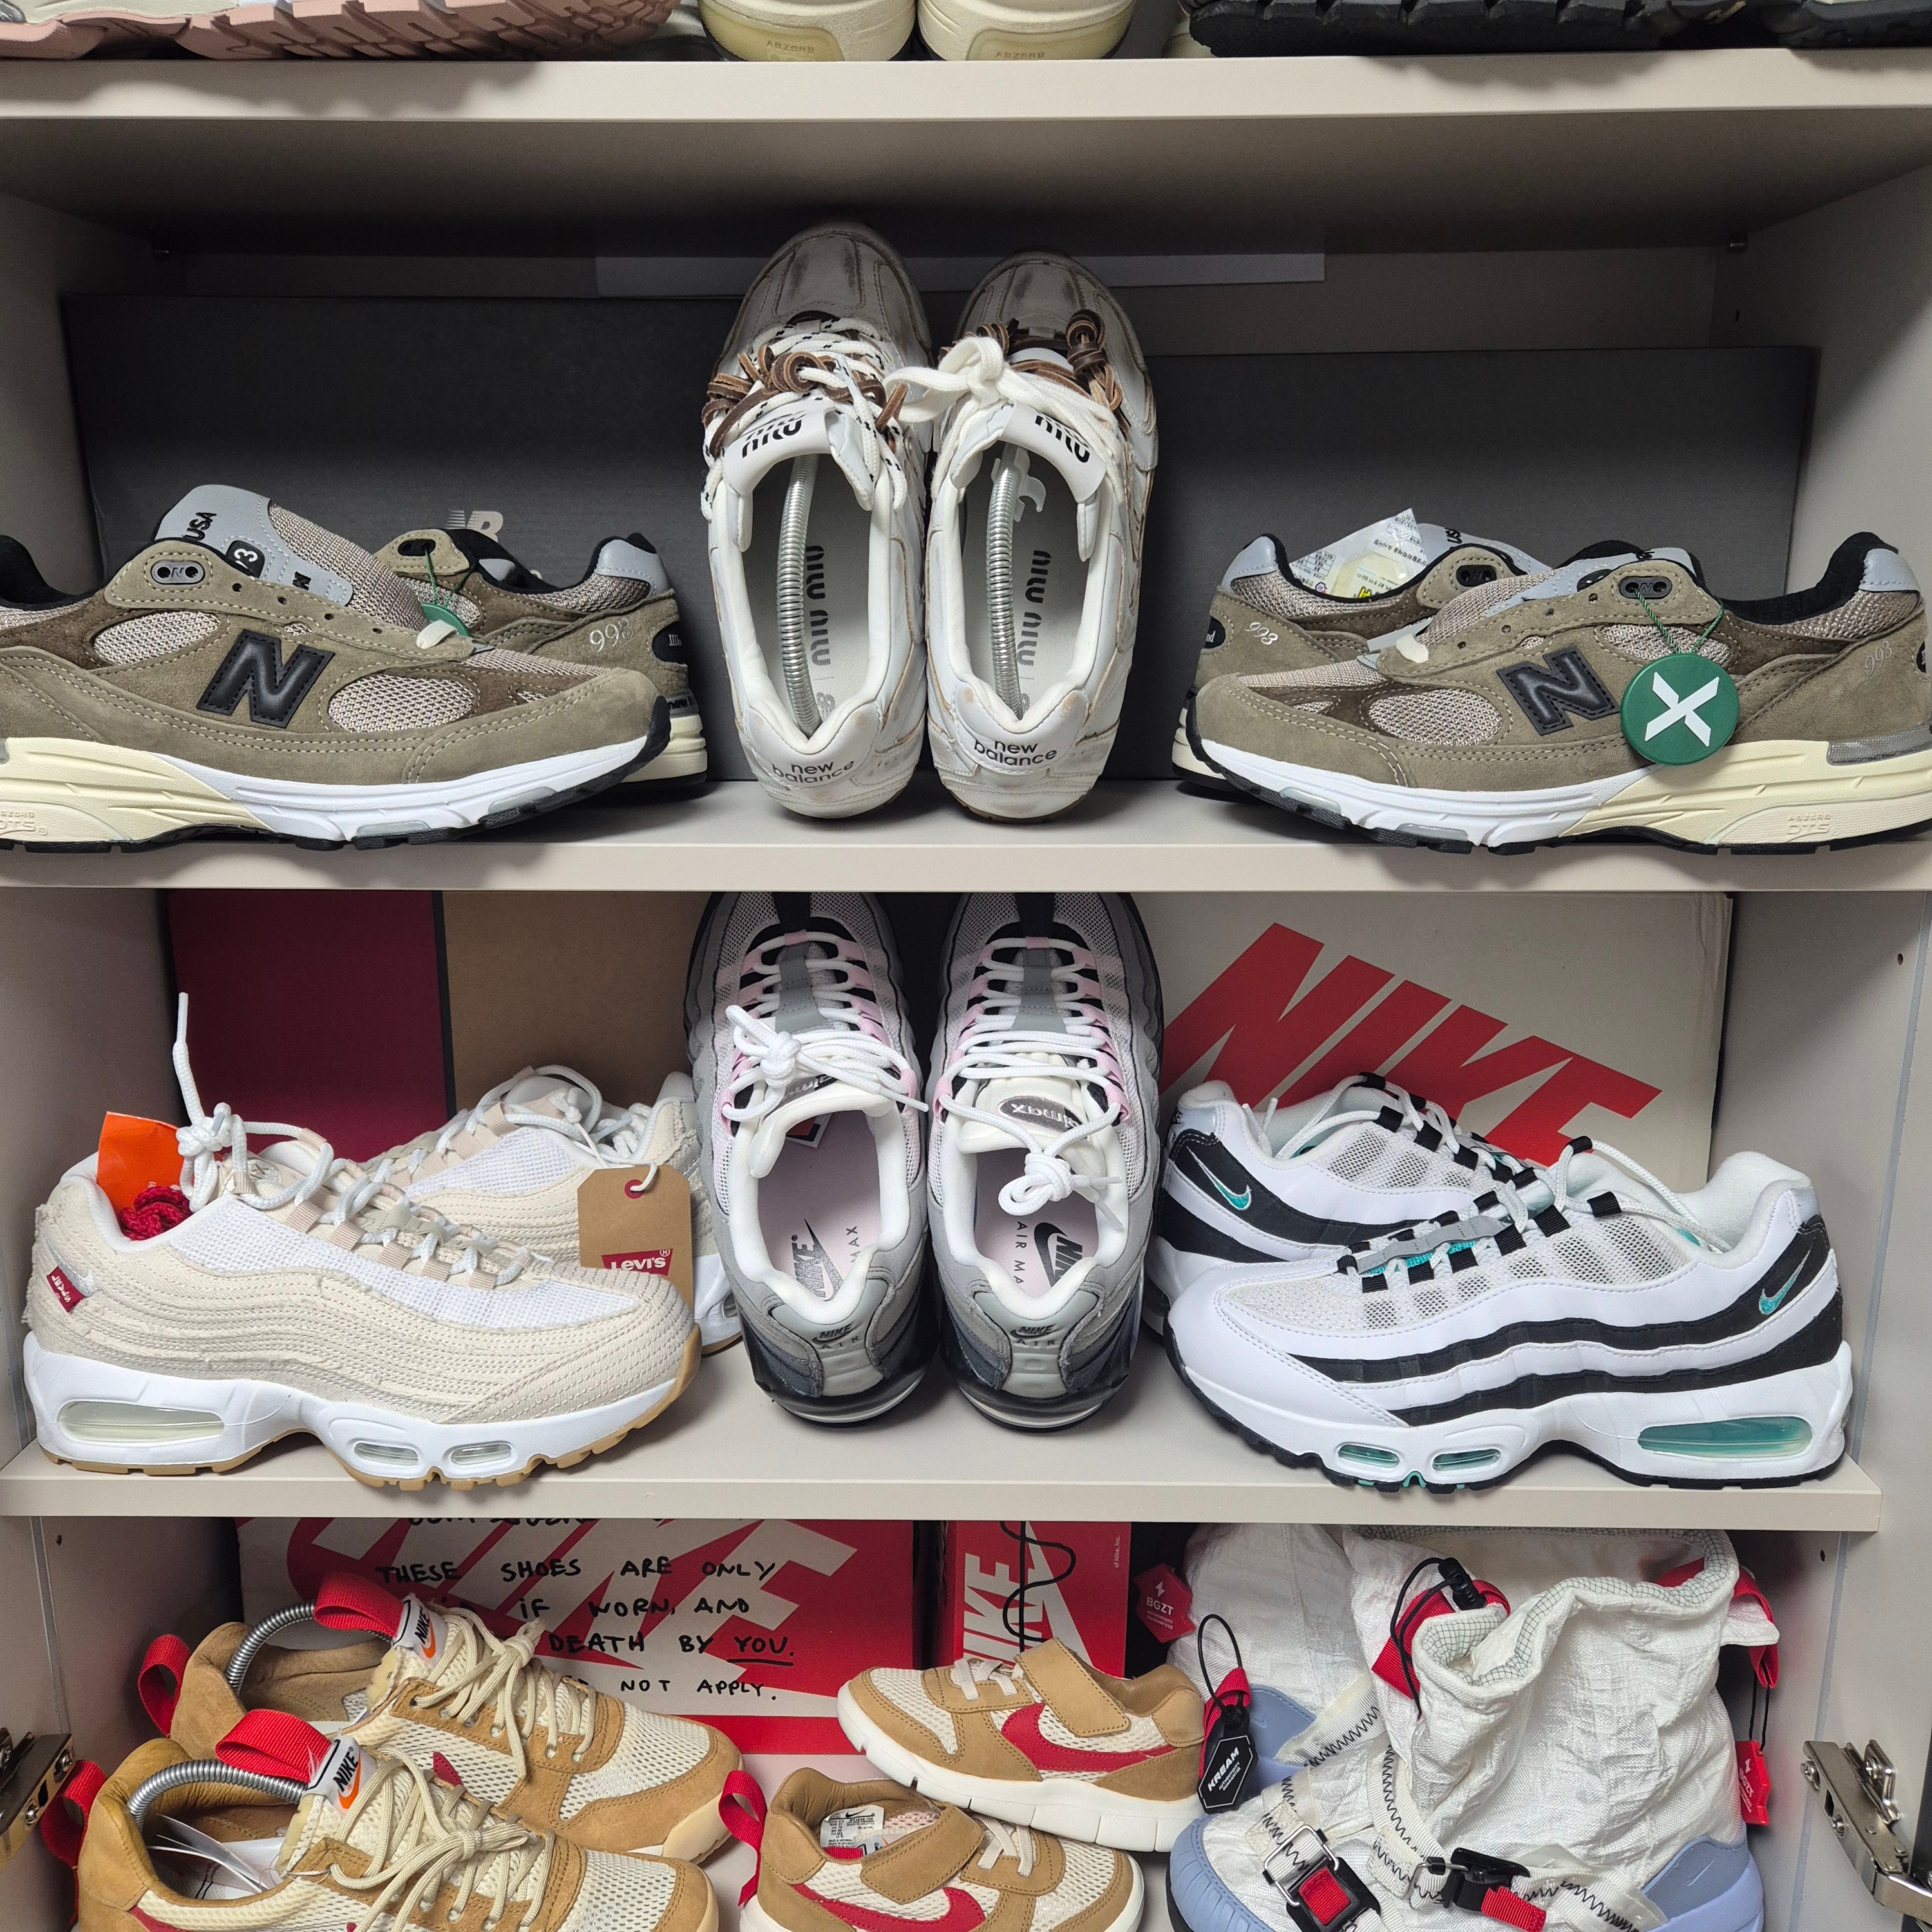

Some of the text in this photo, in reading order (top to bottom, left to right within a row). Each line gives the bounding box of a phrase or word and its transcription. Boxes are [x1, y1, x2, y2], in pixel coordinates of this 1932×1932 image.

[183, 512, 217, 541] USA
[806, 545, 831, 666] miu miu
[1017, 550, 1052, 667] miu miu
[589, 618, 634, 653] 993
[1244, 622, 1278, 645] 993
[1864, 640, 1893, 676] 993
[196, 629, 335, 729] N
[1496, 644, 1621, 736] N
[974, 739, 1057, 766] balance
[994, 739, 1039, 754] new
[773, 760, 854, 784] balance
[791, 761, 834, 775] new
[1014, 1221, 1028, 1283] AIR MA
[819, 1322, 853, 1338] NIKE
[822, 1336, 862, 1349] AIR
[1018, 1323, 1057, 1335] NIKE
[375, 1556, 777, 1584] THESE SHOES ARE ONLY
[588, 1597, 676, 1617] WORN,
[694, 1597, 750, 1614] AND
[963, 1552, 1043, 1669] IKE
[1146, 1596, 1175, 1616] BGZT
[413, 1605, 431, 1645] NIKE
[549, 1634, 795, 1657] DEATH BY YOU.
[620, 1678, 777, 1701] NOT APPLY.
[332, 1751, 359, 1793] NIKE
[1208, 1747, 1240, 1792] KREAM
